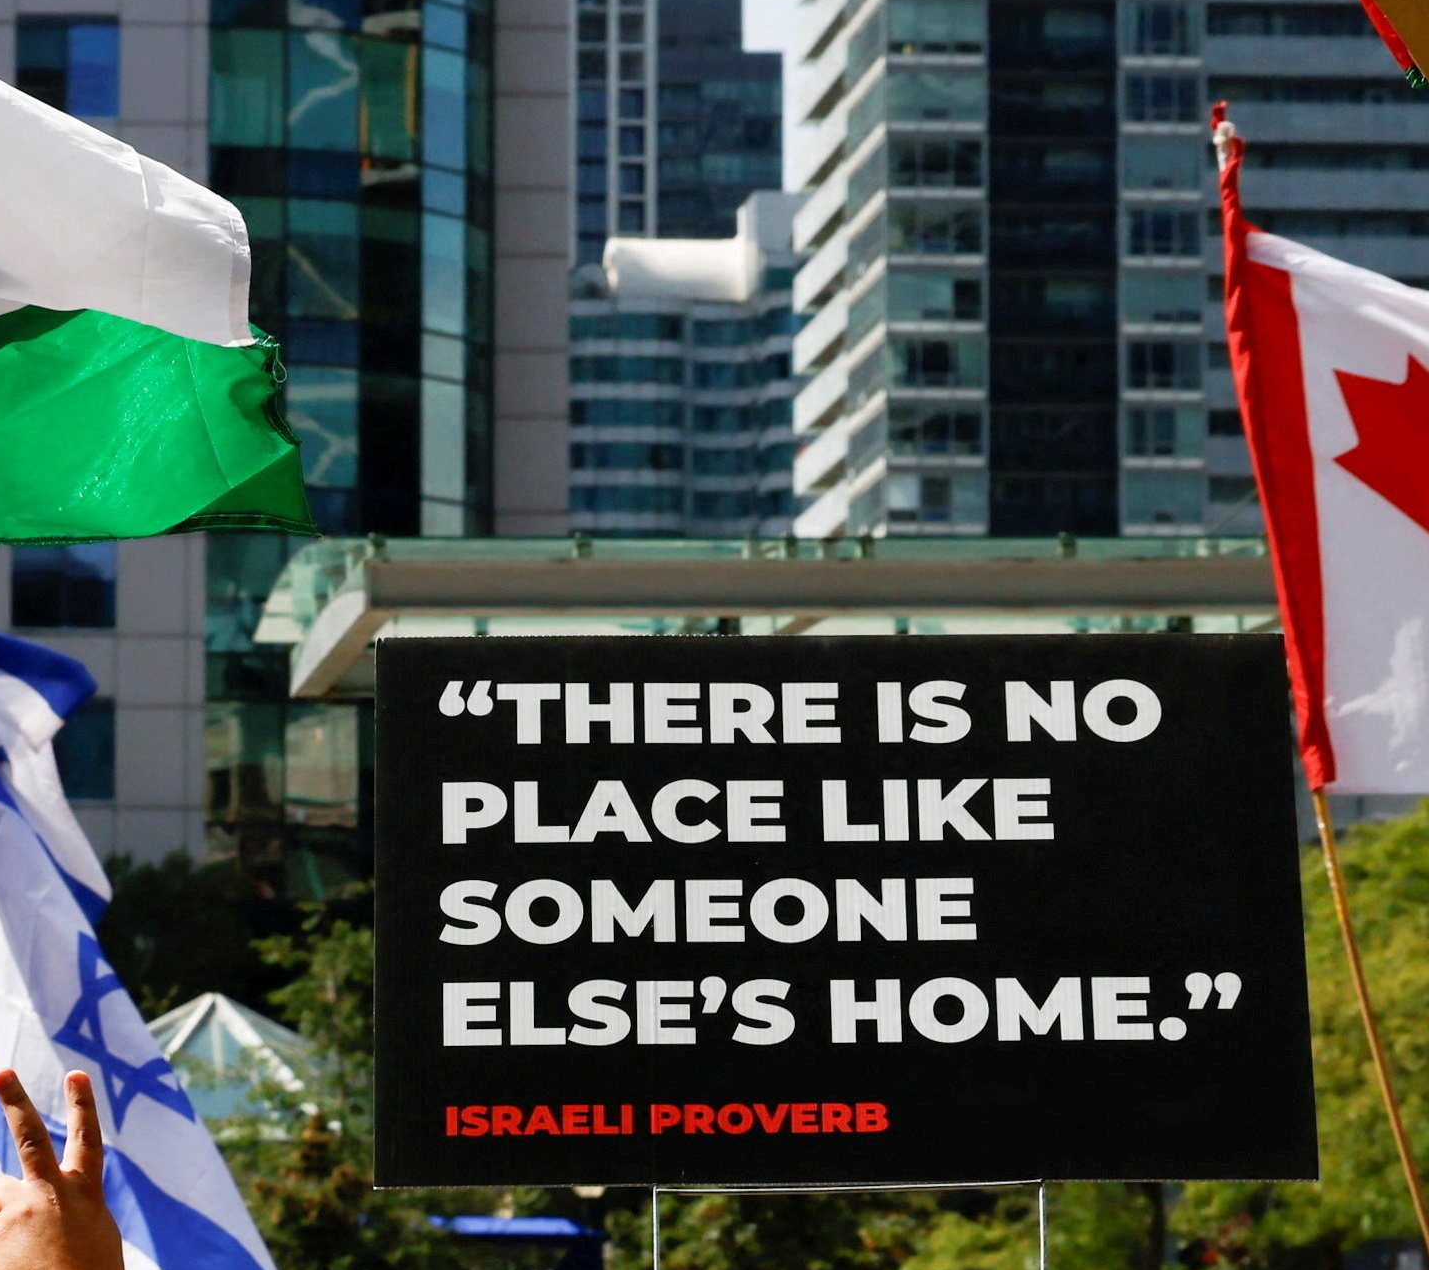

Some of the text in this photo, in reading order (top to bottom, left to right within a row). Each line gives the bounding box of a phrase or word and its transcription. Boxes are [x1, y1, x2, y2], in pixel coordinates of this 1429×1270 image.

[438, 678, 1162, 745] “THERE IS NO
[442, 777, 1055, 845] PLACE LIKE
[438, 877, 978, 946] SOMEONE
[442, 971, 1242, 1047] ELSE’S HOME.”
[444, 1101, 891, 1138] ISRAELI PROVERB
